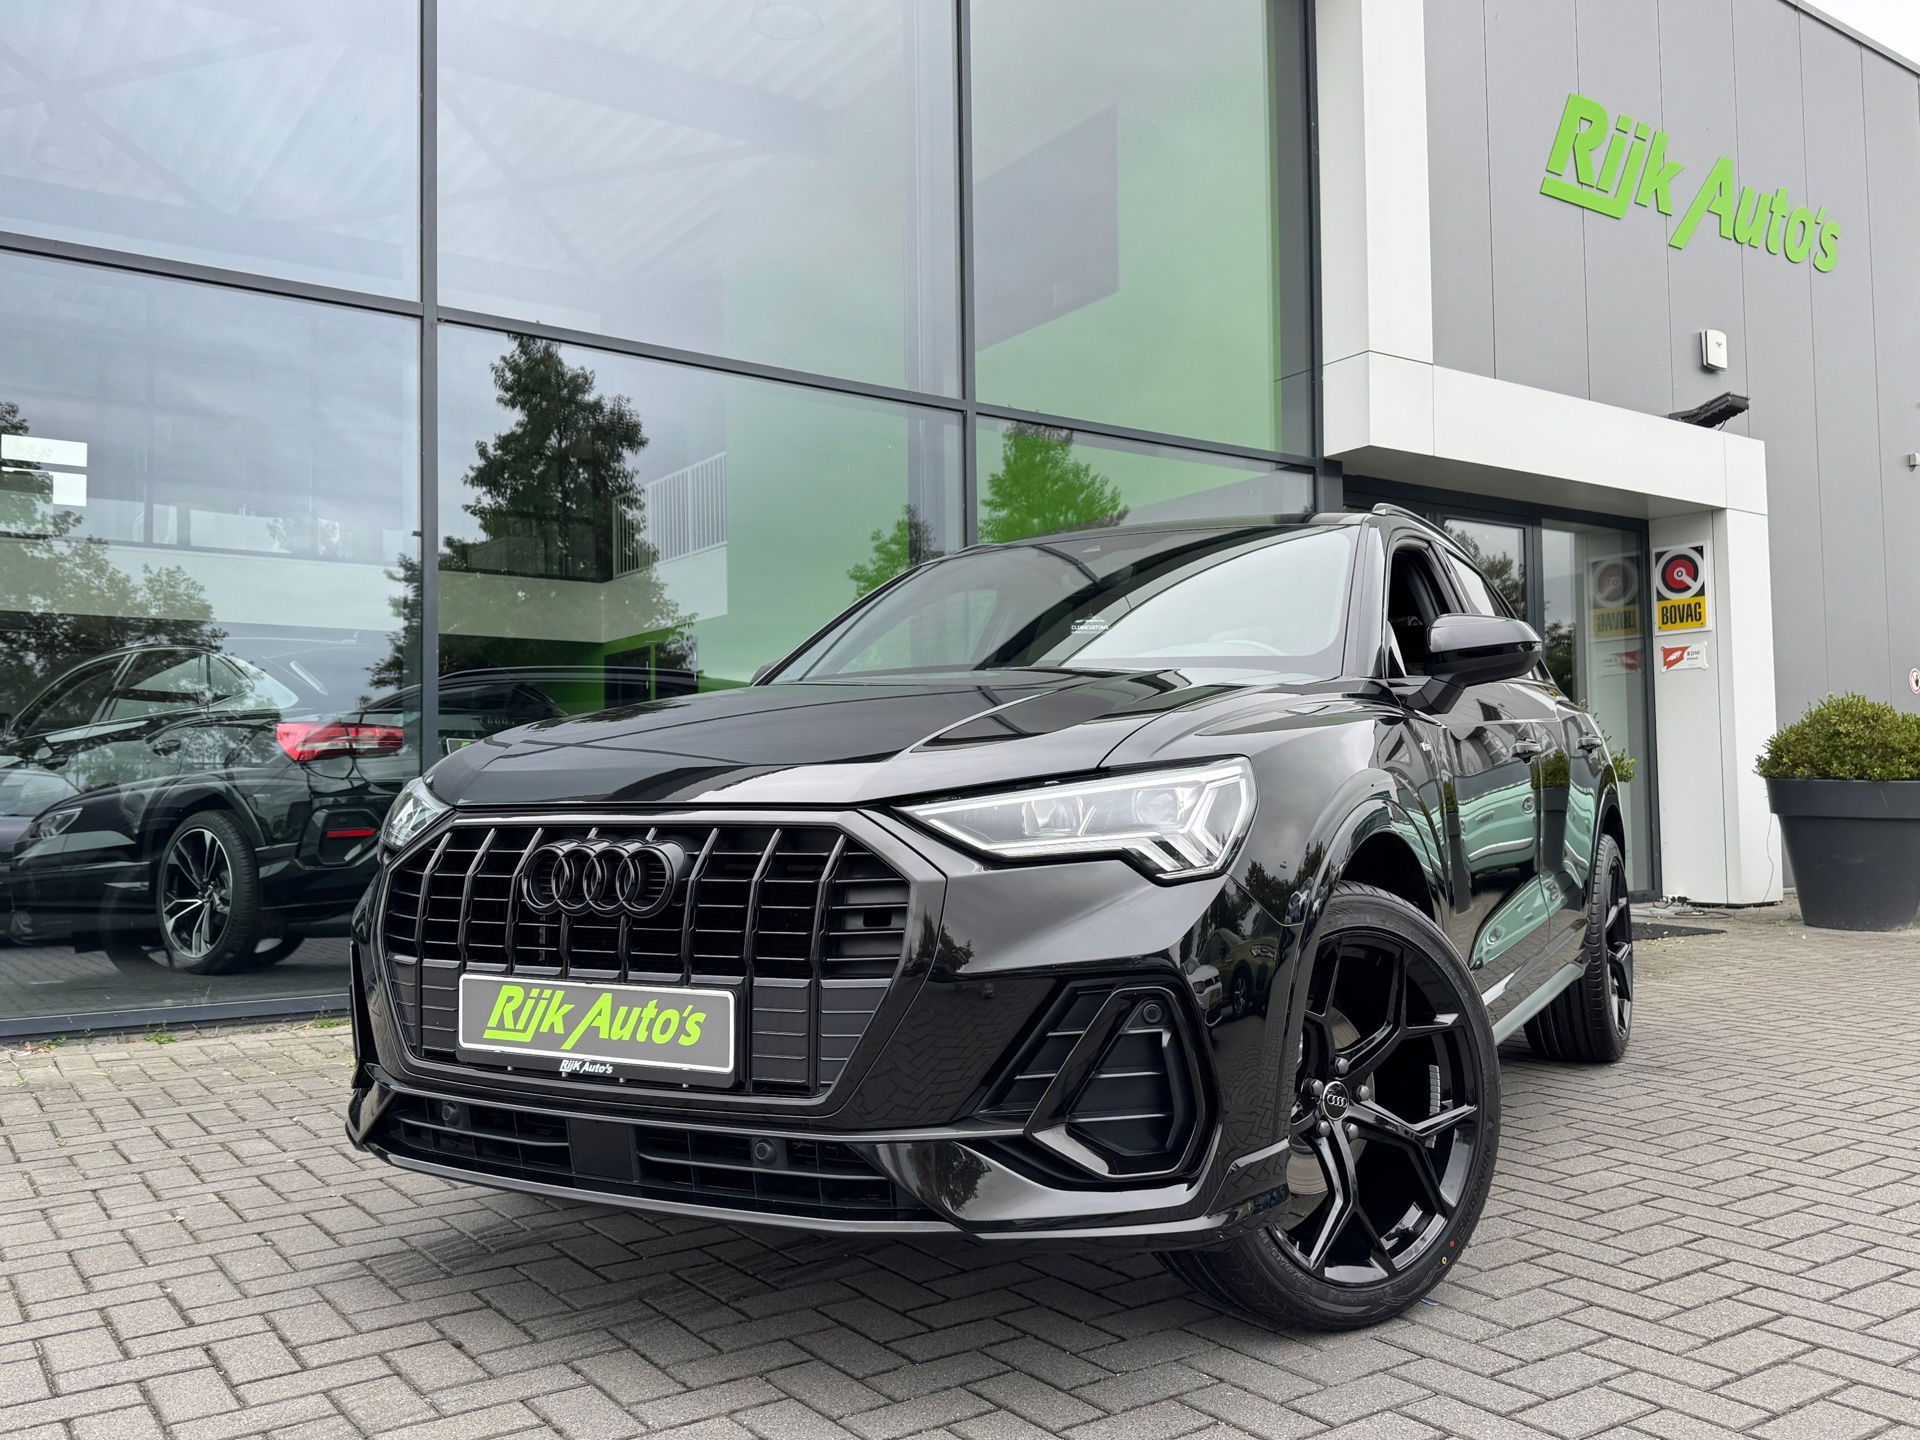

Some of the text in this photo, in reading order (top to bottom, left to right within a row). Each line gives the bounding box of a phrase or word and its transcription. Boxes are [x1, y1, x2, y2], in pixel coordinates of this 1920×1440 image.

[1539, 92, 1842, 274] Rijk Auto's
[1661, 602, 1702, 626] BOVAG
[483, 985, 707, 1050] Rijk Auto's
[580, 1061, 614, 1074] Auto's
